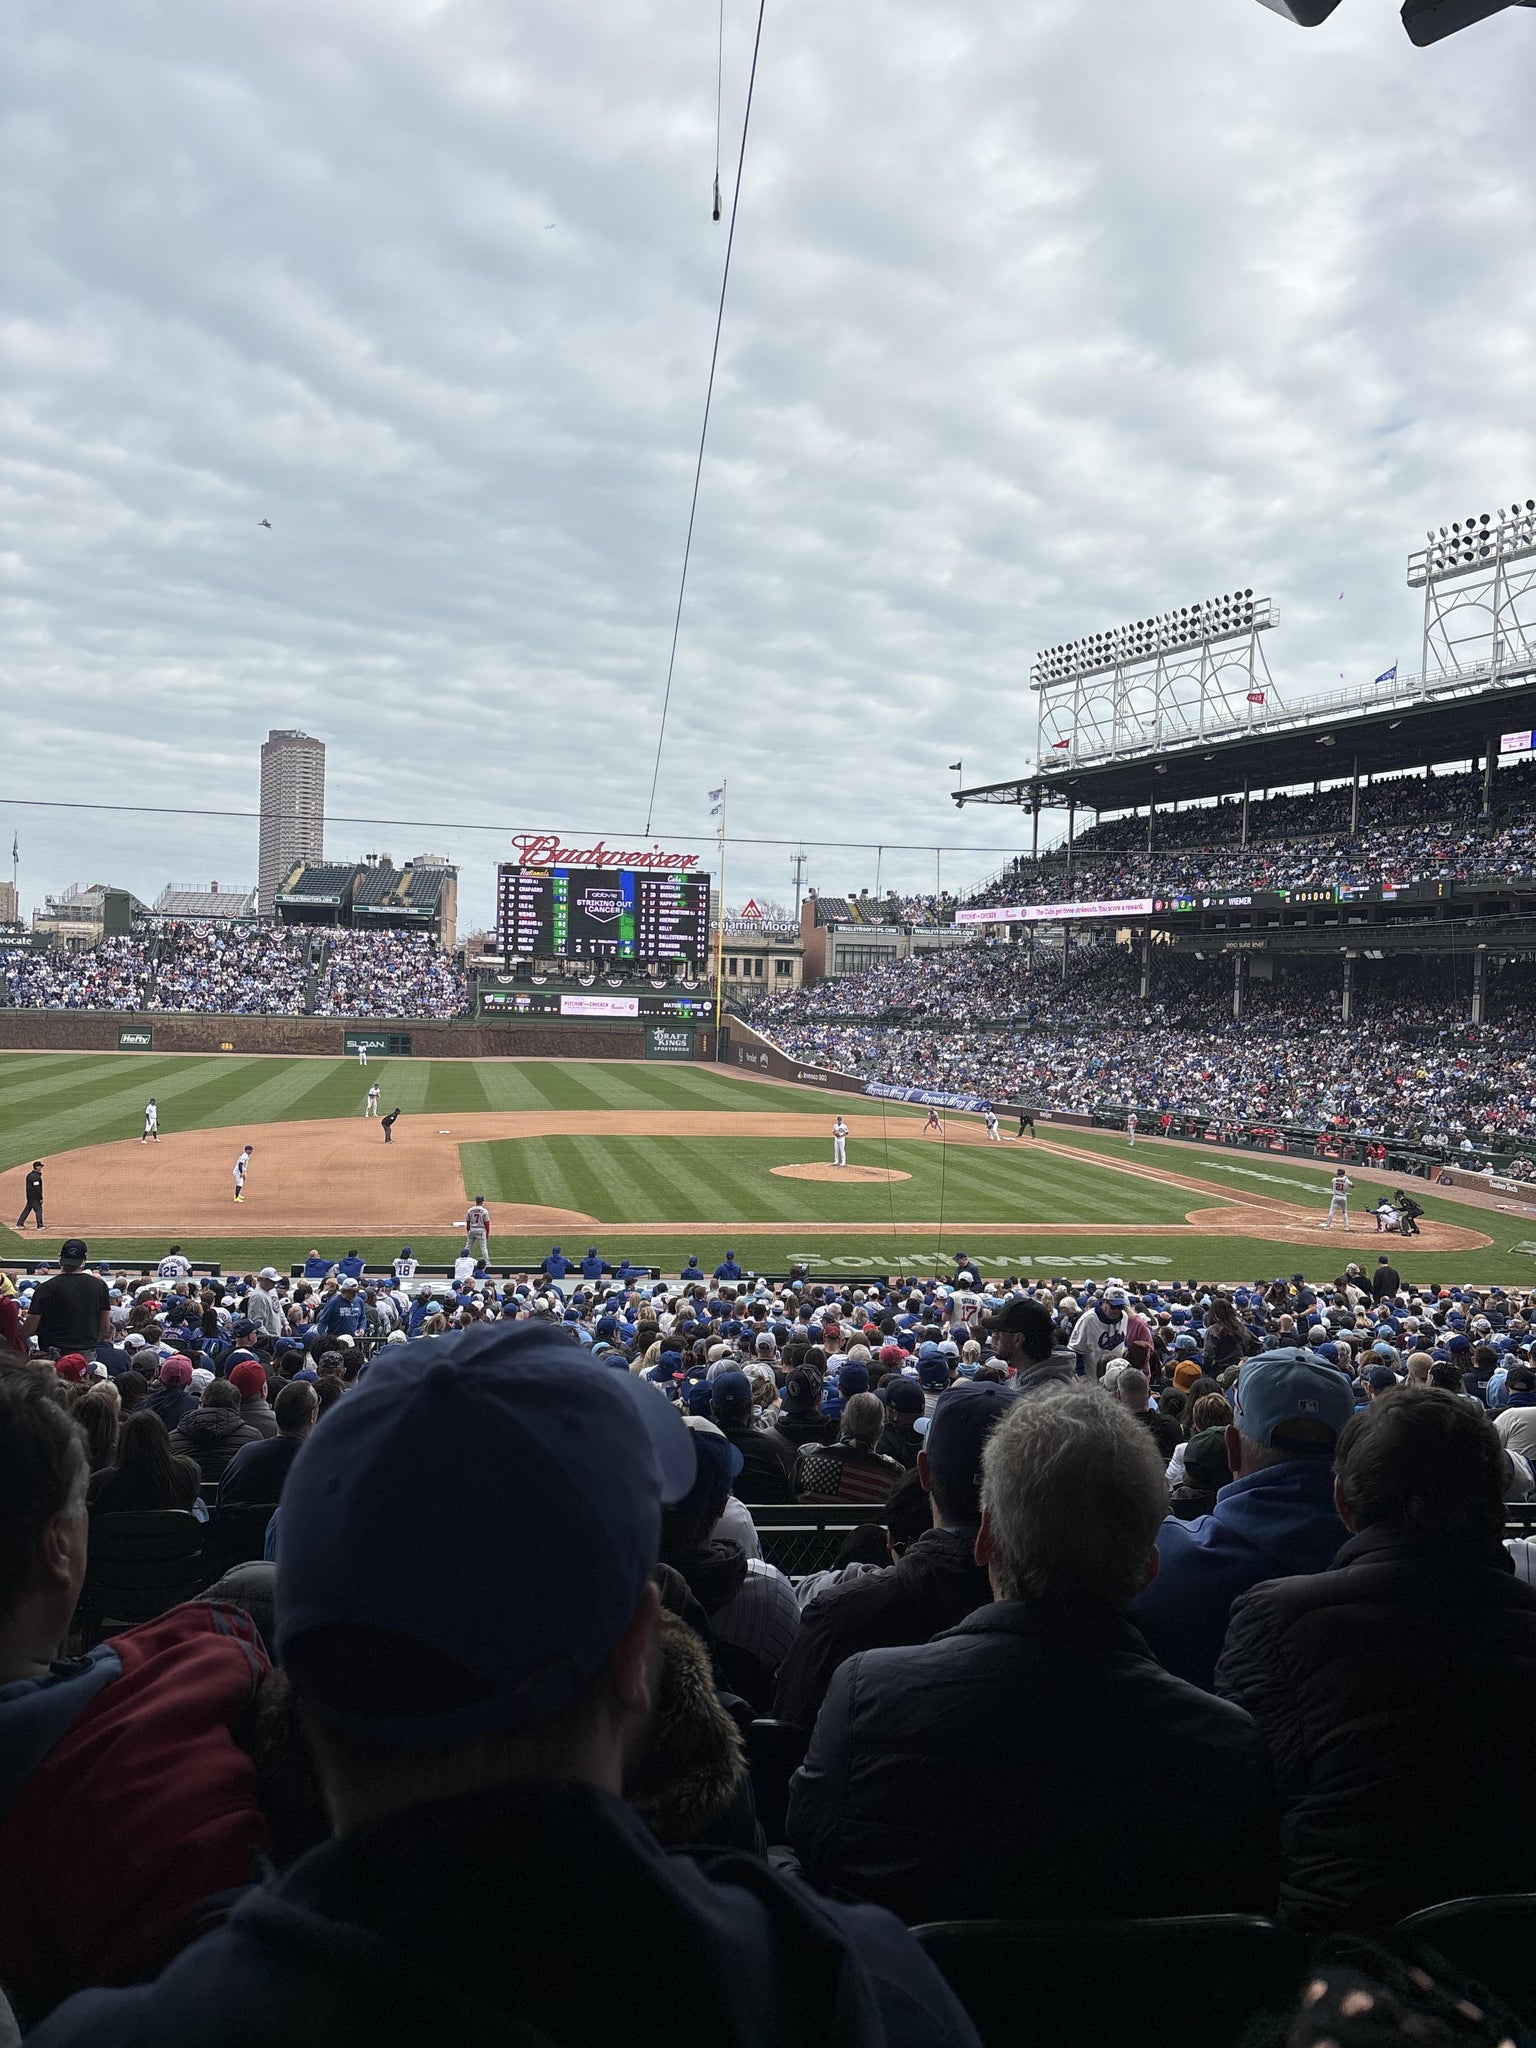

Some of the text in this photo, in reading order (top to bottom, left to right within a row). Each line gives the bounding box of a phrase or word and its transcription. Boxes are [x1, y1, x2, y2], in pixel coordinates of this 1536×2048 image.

[512, 835, 700, 868] Budweiser
[1229, 897, 1251, 905] WIEMER
[709, 920, 799, 932] enjamin Moore
[123, 1035, 148, 1044] Hefty
[654, 1032, 688, 1040] DRAFT
[804, 1072, 818, 1080] Invesco
[866, 1085, 905, 1100] Reynolds Wrap
[920, 1093, 966, 1110] Reynolds Wrap
[474, 1214, 479, 1223] 7
[164, 1266, 177, 1277] 25
[398, 1265, 410, 1276] 18
[961, 1305, 977, 1321] 17
